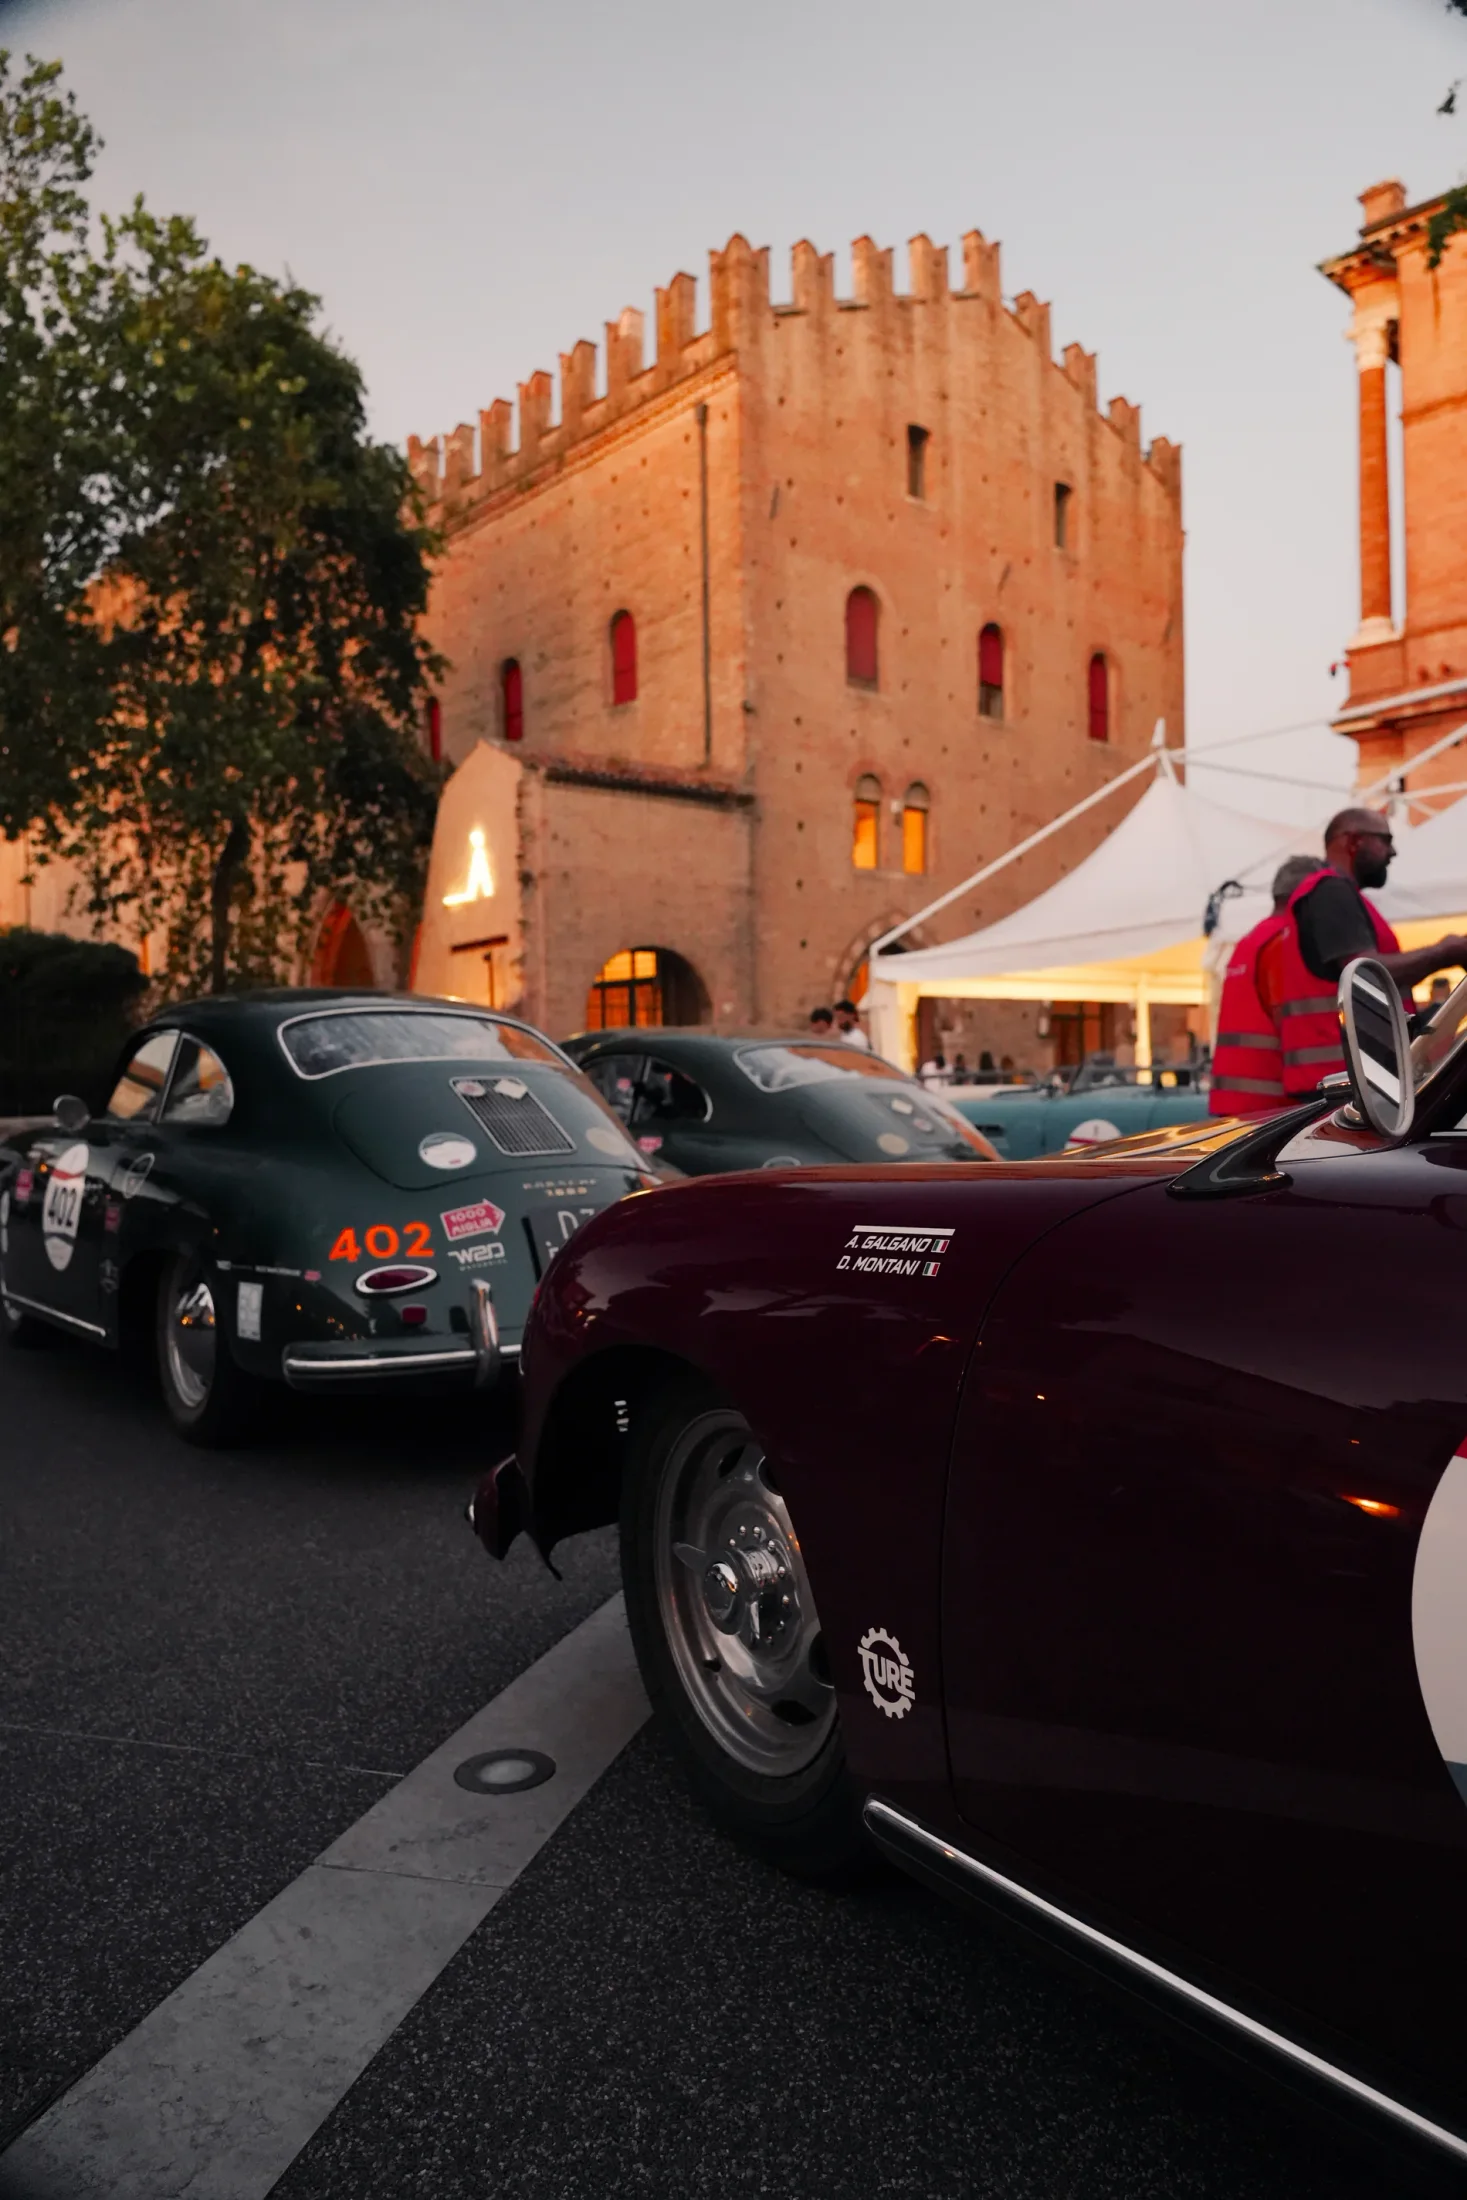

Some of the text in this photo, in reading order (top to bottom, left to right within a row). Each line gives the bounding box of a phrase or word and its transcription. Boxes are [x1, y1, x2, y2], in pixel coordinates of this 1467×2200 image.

[450, 1207, 486, 1223] 1000
[328, 1221, 434, 1262] 402
[844, 1234, 932, 1252] A. GALGANO
[836, 1255, 921, 1275] D. MONTANI
[857, 1646, 916, 1700] TURE
